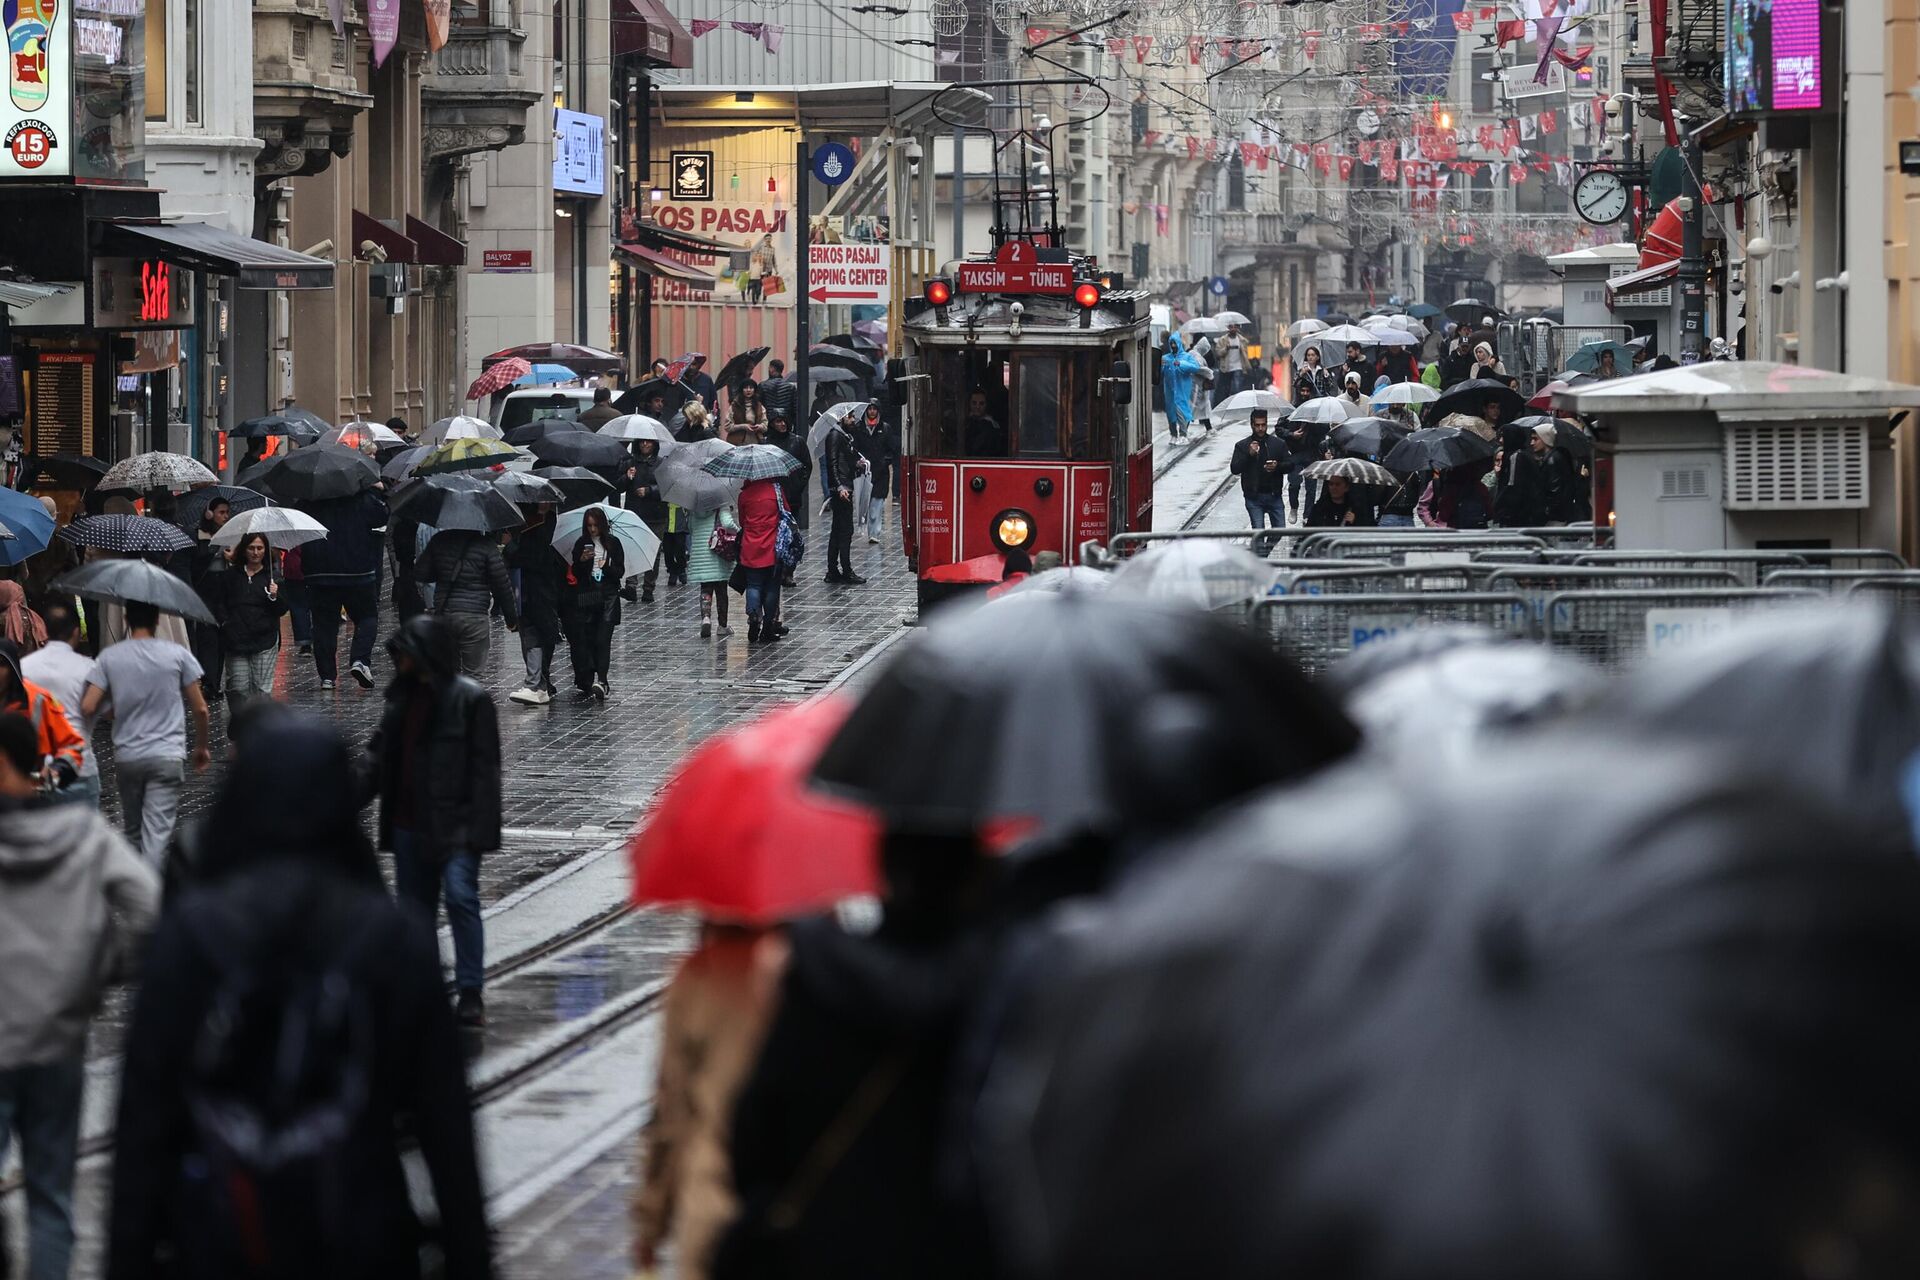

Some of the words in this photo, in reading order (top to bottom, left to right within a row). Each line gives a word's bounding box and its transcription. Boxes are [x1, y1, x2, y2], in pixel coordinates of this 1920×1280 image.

[6, 120, 56, 142] REFLEXOLOGY
[15, 133, 44, 153] 15
[17, 153, 45, 162] EURO
[701, 207, 787, 233] PASAJI
[485, 253, 512, 261] BALYOZ
[845, 246, 880, 264] PASAJI
[1011, 243, 1020, 262] 2
[809, 268, 846, 286] OPPING
[848, 268, 888, 286] CENTER
[963, 267, 1006, 286] TAKSİM
[1029, 268, 1067, 288] TÜNEL
[925, 478, 937, 494] 223
[1090, 481, 1103, 497] 223
